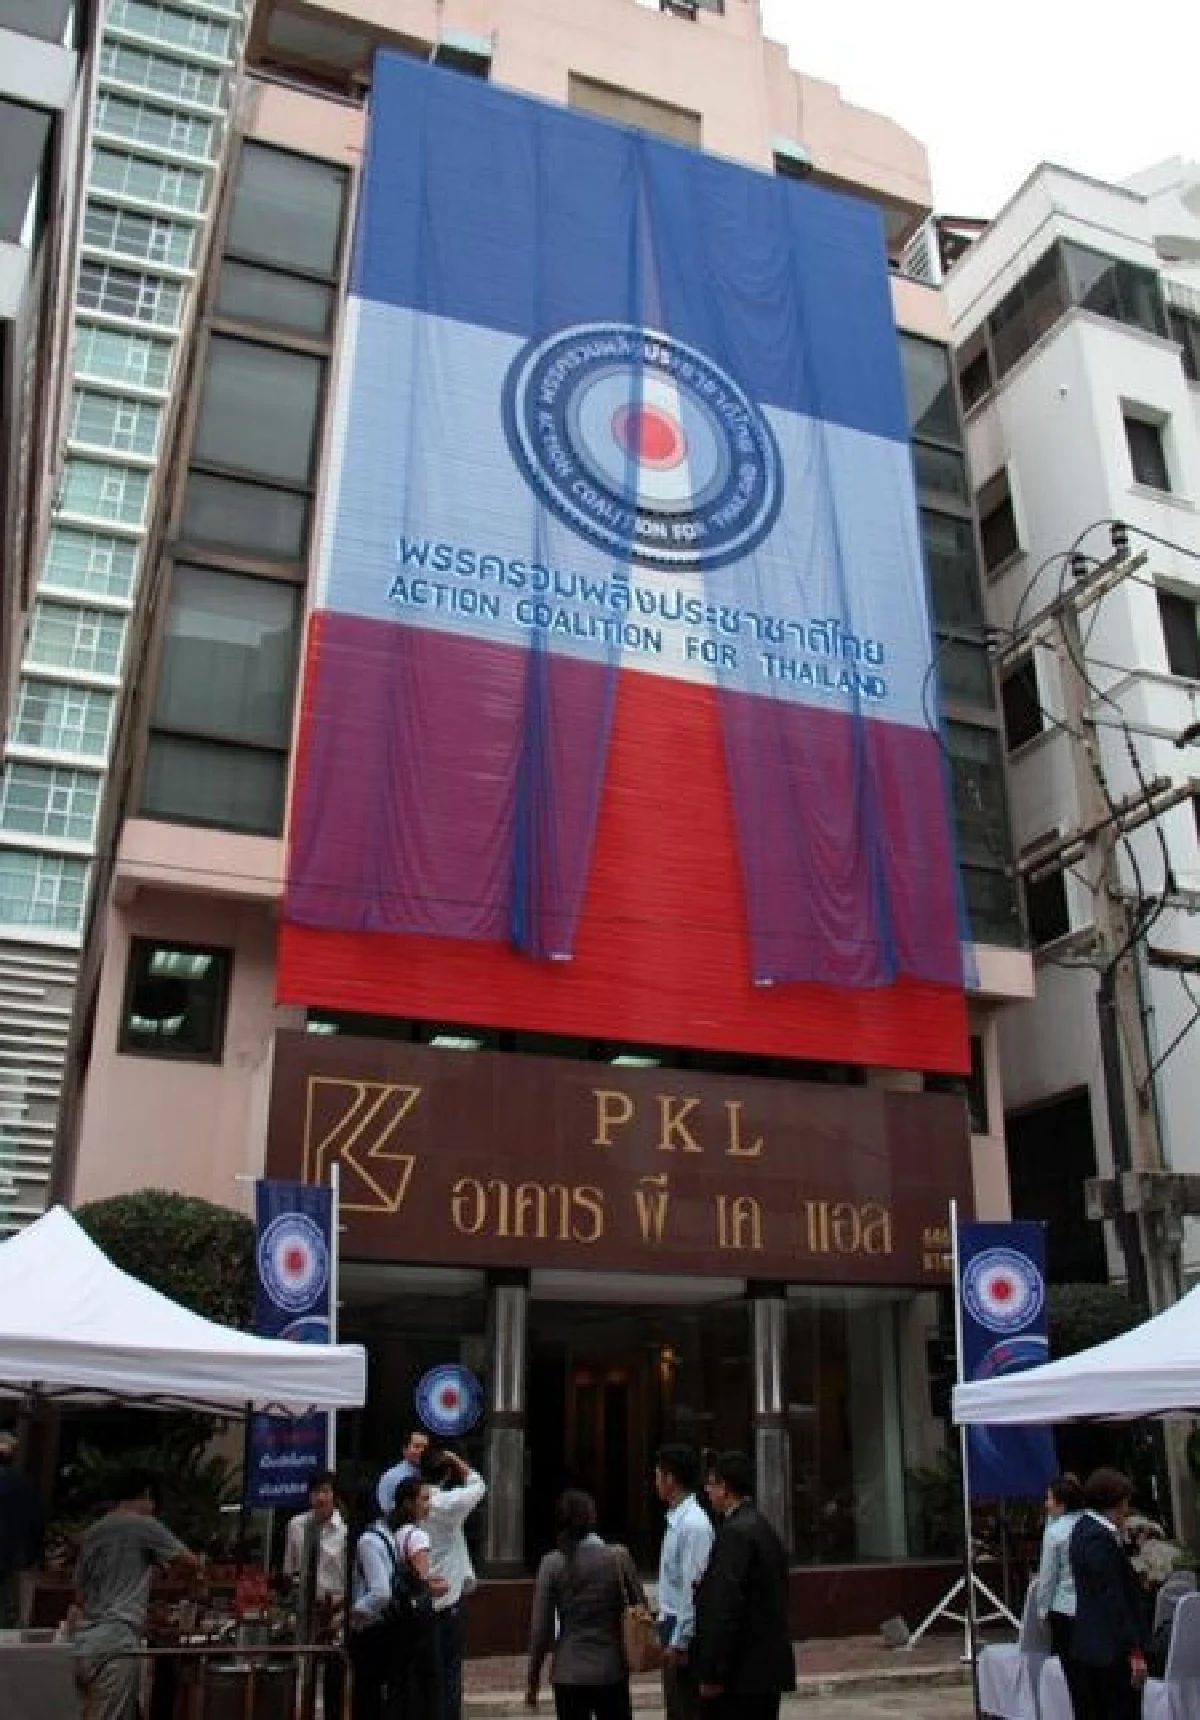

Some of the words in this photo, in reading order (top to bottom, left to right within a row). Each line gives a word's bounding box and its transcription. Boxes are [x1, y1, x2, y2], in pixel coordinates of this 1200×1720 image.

[389, 575, 500, 617] ACTION
[516, 599, 662, 653] COALITION
[687, 636, 738, 669] FOR
[761, 652, 887, 699] THAILAND
[451, 1178, 605, 1244] อาคาร
[715, 1194, 764, 1250] เค
[804, 1201, 894, 1254] แอล
